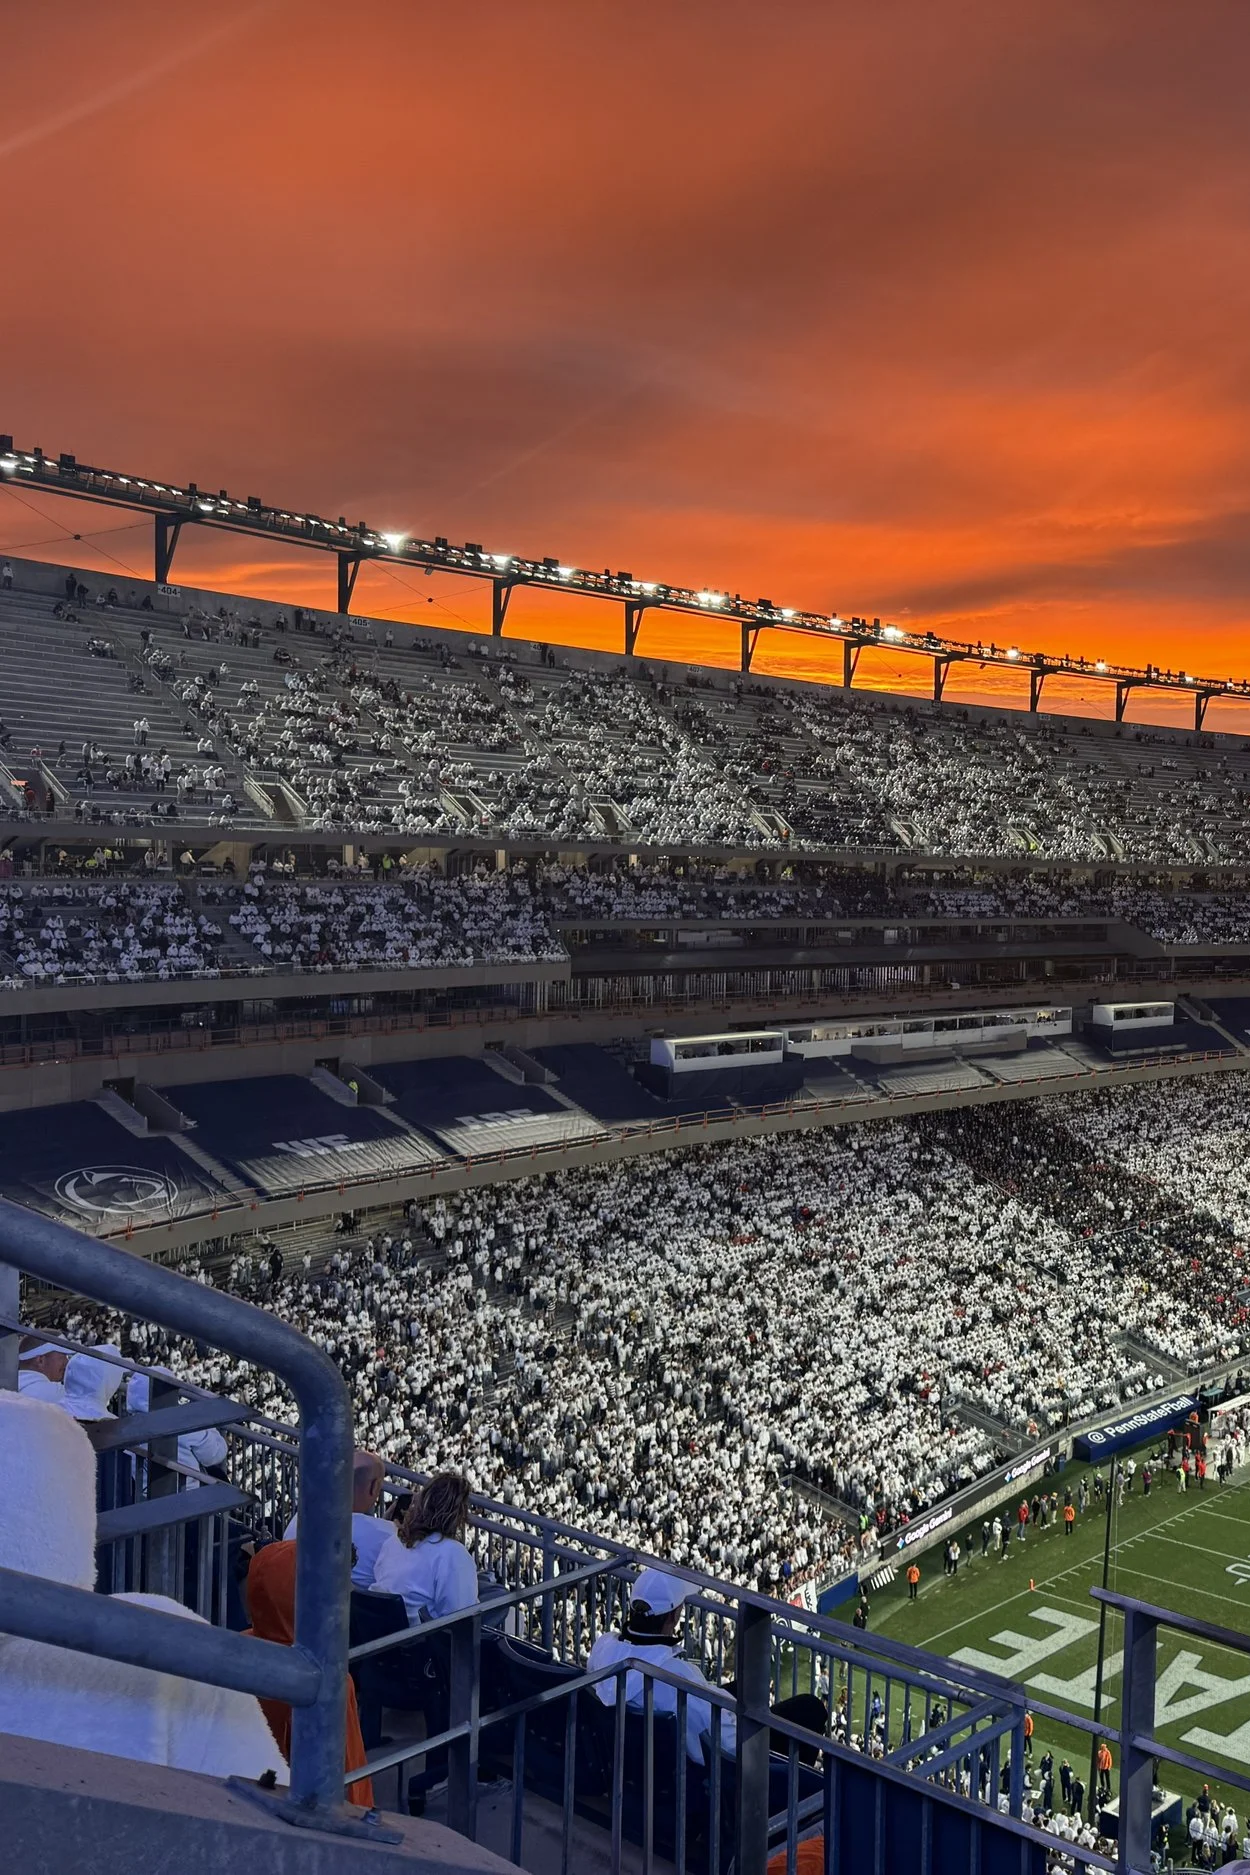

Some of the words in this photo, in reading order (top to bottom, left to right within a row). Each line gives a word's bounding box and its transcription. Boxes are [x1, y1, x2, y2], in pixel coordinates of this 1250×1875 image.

[455, 1108, 549, 1131] ARE
[272, 1134, 365, 1158] WE
[1087, 1431, 1106, 1443] @
[1103, 1396, 1195, 1437] PennStateFball
[1011, 1462, 1031, 1478] Google
[1030, 1448, 1050, 1466] Gemini
[904, 1522, 929, 1545] Google
[928, 1507, 953, 1530] Gemini
